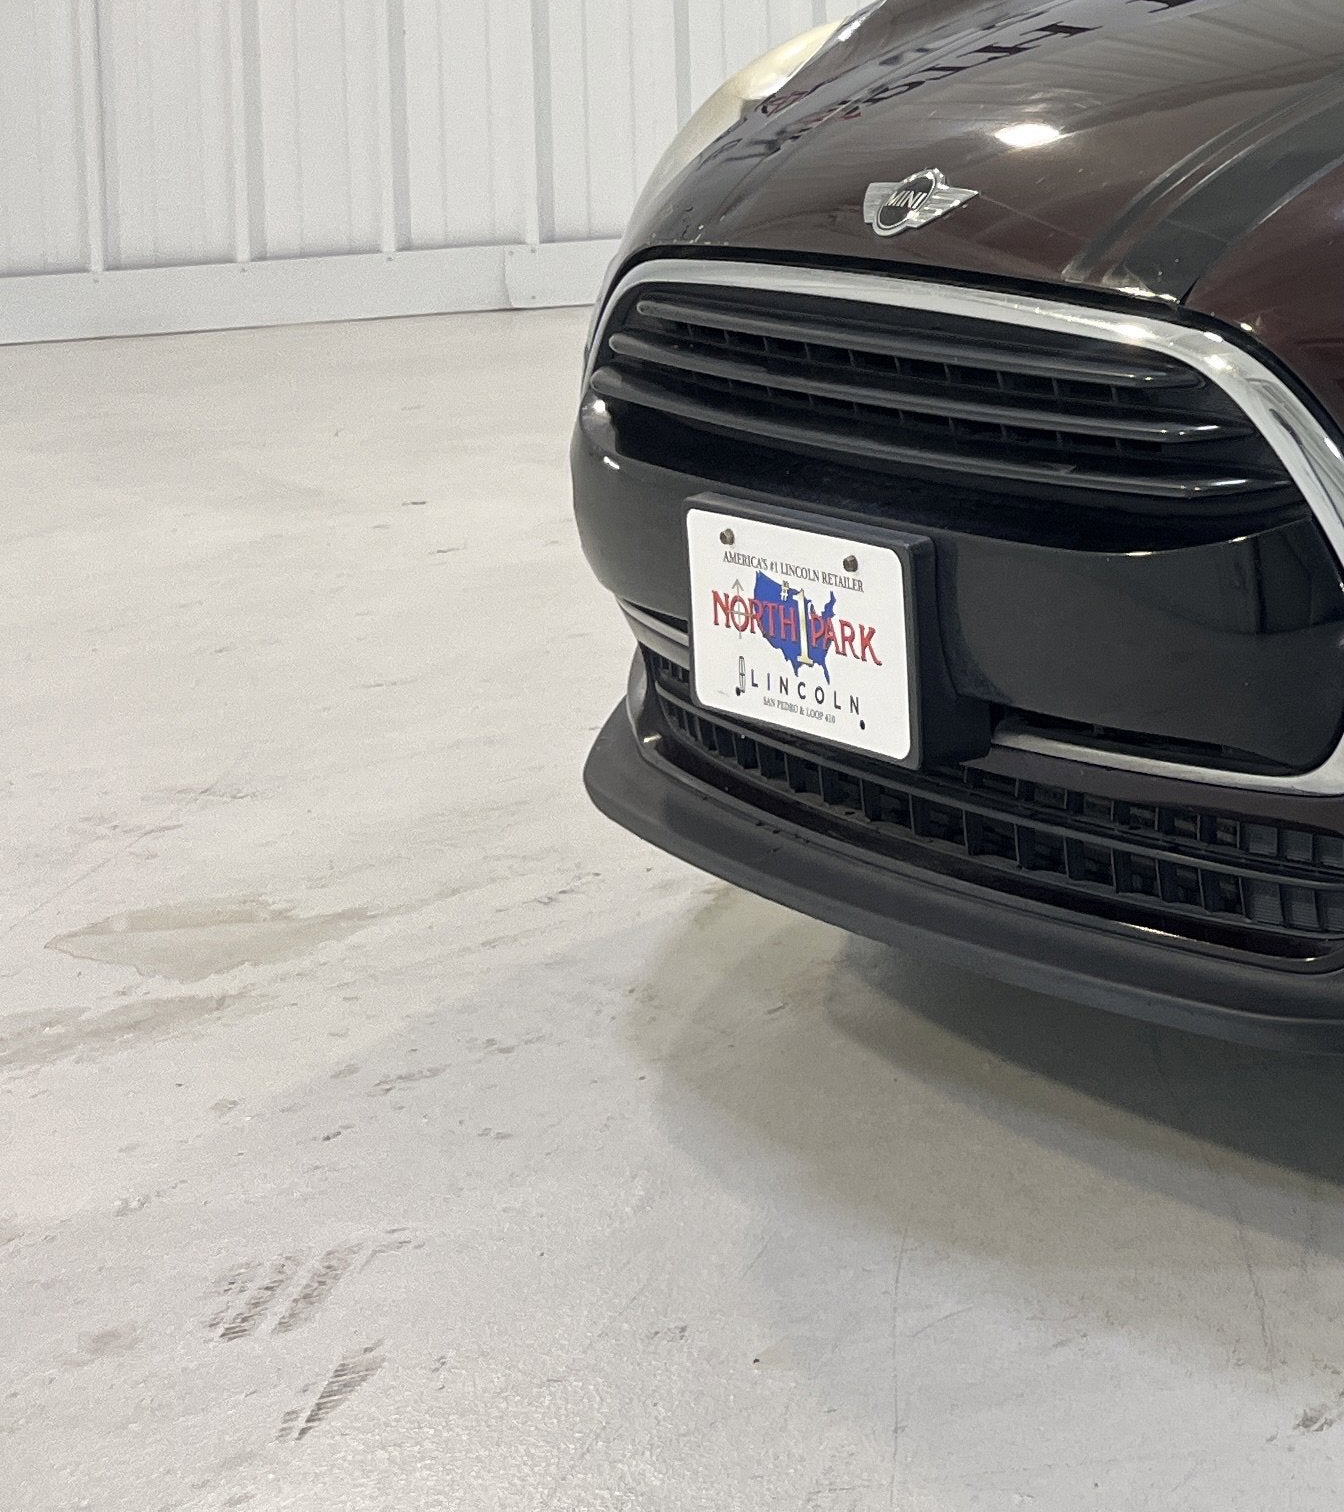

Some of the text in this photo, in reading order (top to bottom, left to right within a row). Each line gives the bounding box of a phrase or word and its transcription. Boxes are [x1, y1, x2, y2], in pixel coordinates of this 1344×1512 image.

[887, 190, 927, 209] MINI
[780, 562, 820, 582] LINCOLN
[822, 573, 864, 593] RETAILER
[713, 590, 882, 666] NORTH PARK
[751, 669, 859, 715] LINCOLN
[763, 695, 776, 707] SAN
